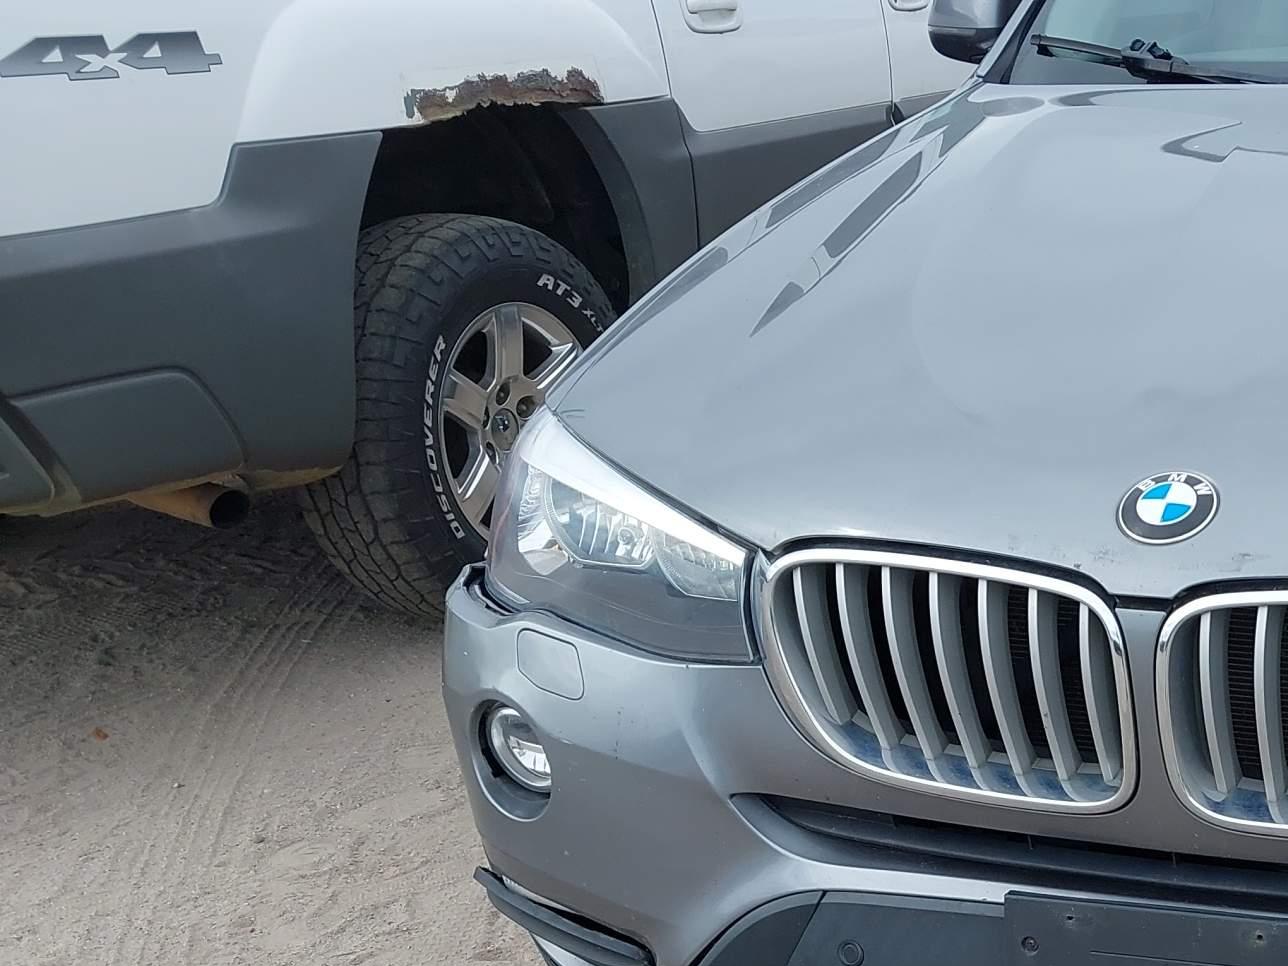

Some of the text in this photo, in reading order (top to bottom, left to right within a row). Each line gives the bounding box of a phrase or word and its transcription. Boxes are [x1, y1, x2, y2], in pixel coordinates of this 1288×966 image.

[537, 273, 583, 308] AT3
[423, 335, 466, 540] DISCOVERER
[1137, 472, 1213, 496] BMW
